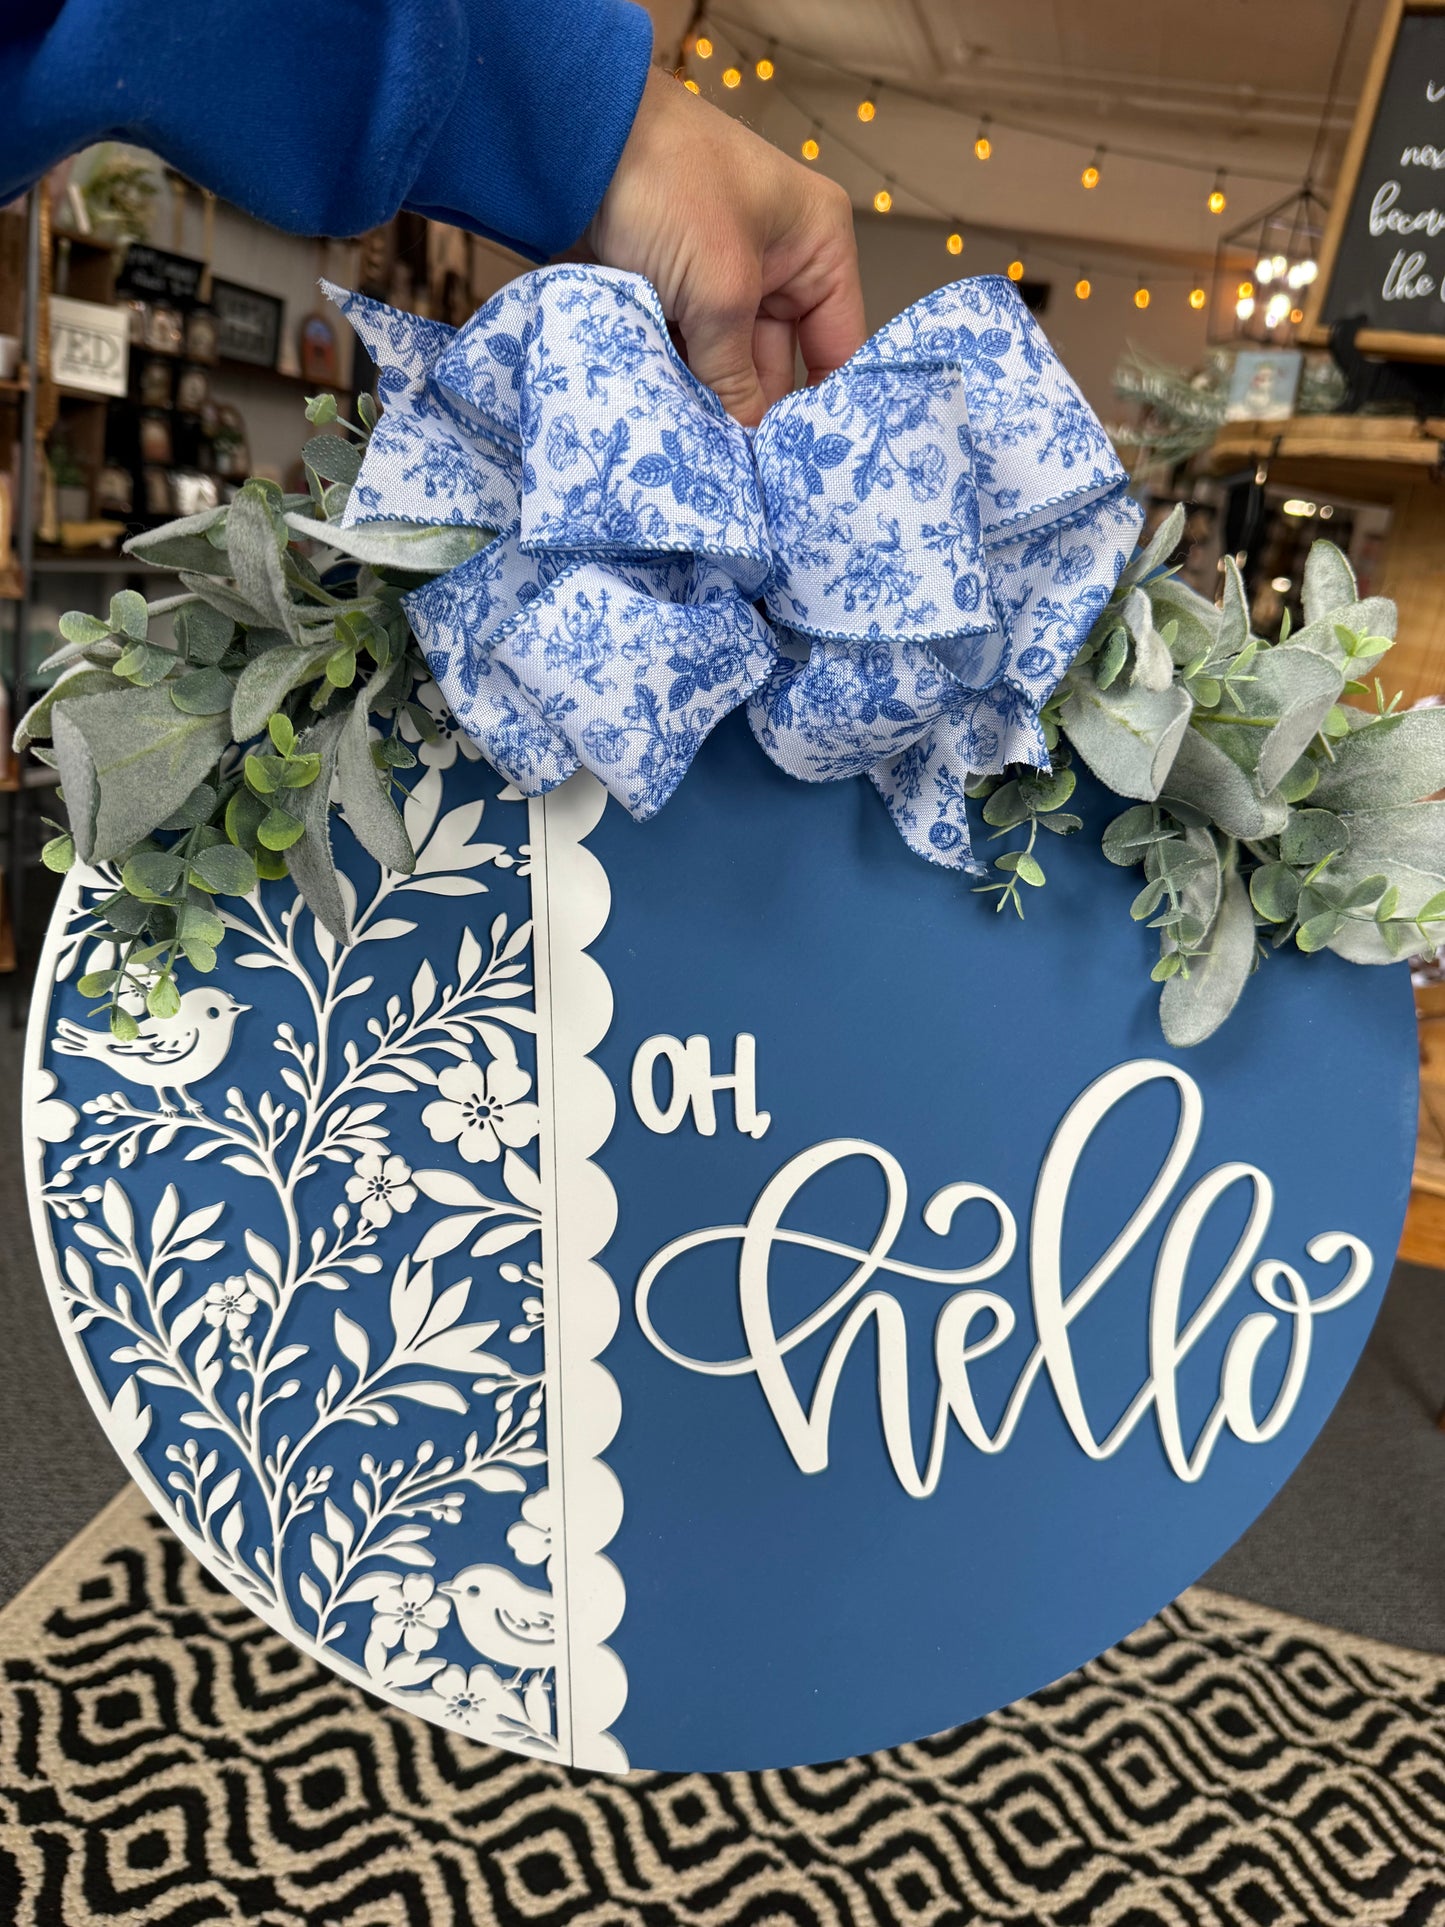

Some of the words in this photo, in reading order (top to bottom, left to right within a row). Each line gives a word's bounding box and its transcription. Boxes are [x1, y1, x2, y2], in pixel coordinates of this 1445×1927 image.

[1382, 248, 1436, 301] the
[632, 1032, 772, 1139] OH,
[635, 1058, 1374, 1498] hello
